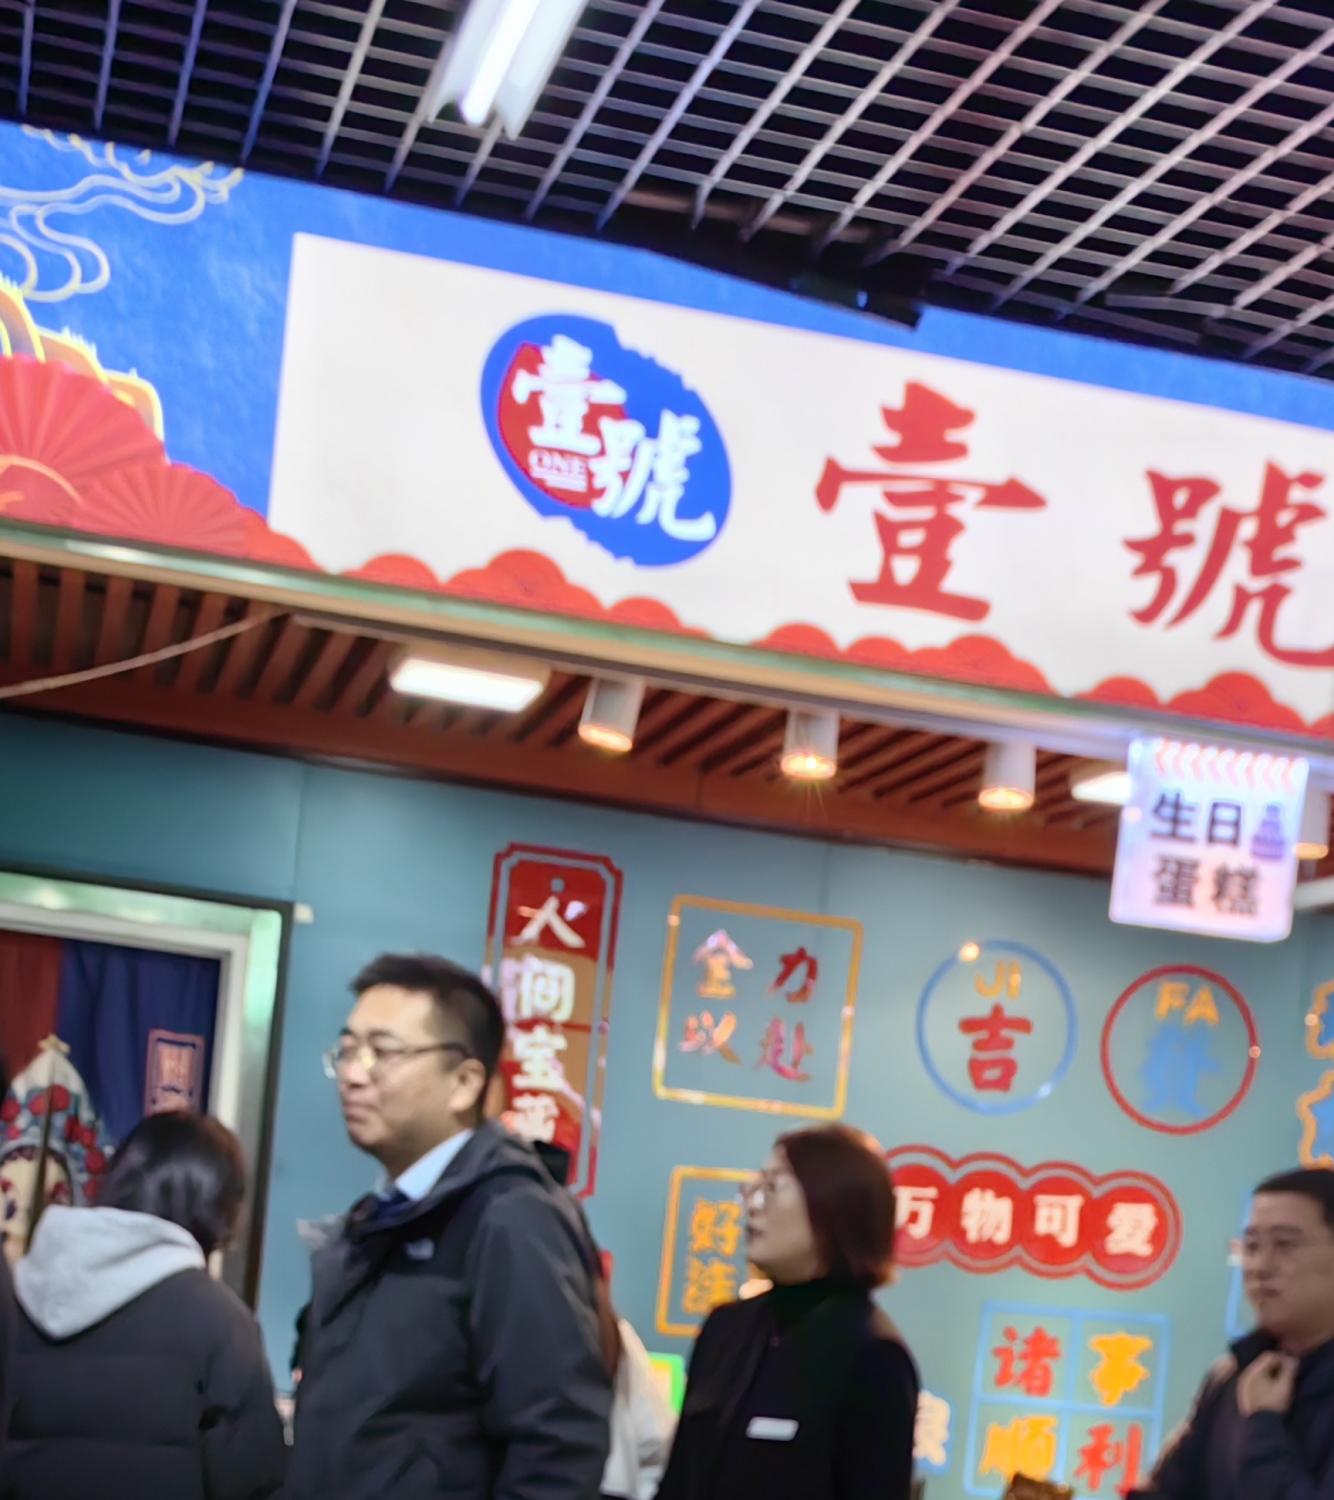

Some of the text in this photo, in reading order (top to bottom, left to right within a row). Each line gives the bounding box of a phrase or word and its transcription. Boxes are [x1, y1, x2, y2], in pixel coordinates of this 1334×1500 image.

[528, 449, 587, 478] ONE
[1150, 791, 1244, 846] 生日
[1153, 854, 1260, 917] 蛋糕
[975, 959, 1021, 998] JI
[1156, 982, 1220, 1025] FA
[958, 1003, 1034, 1093] 吉
[893, 1186, 1158, 1257] 万物可爱
[992, 1326, 1152, 1407] 诸事
